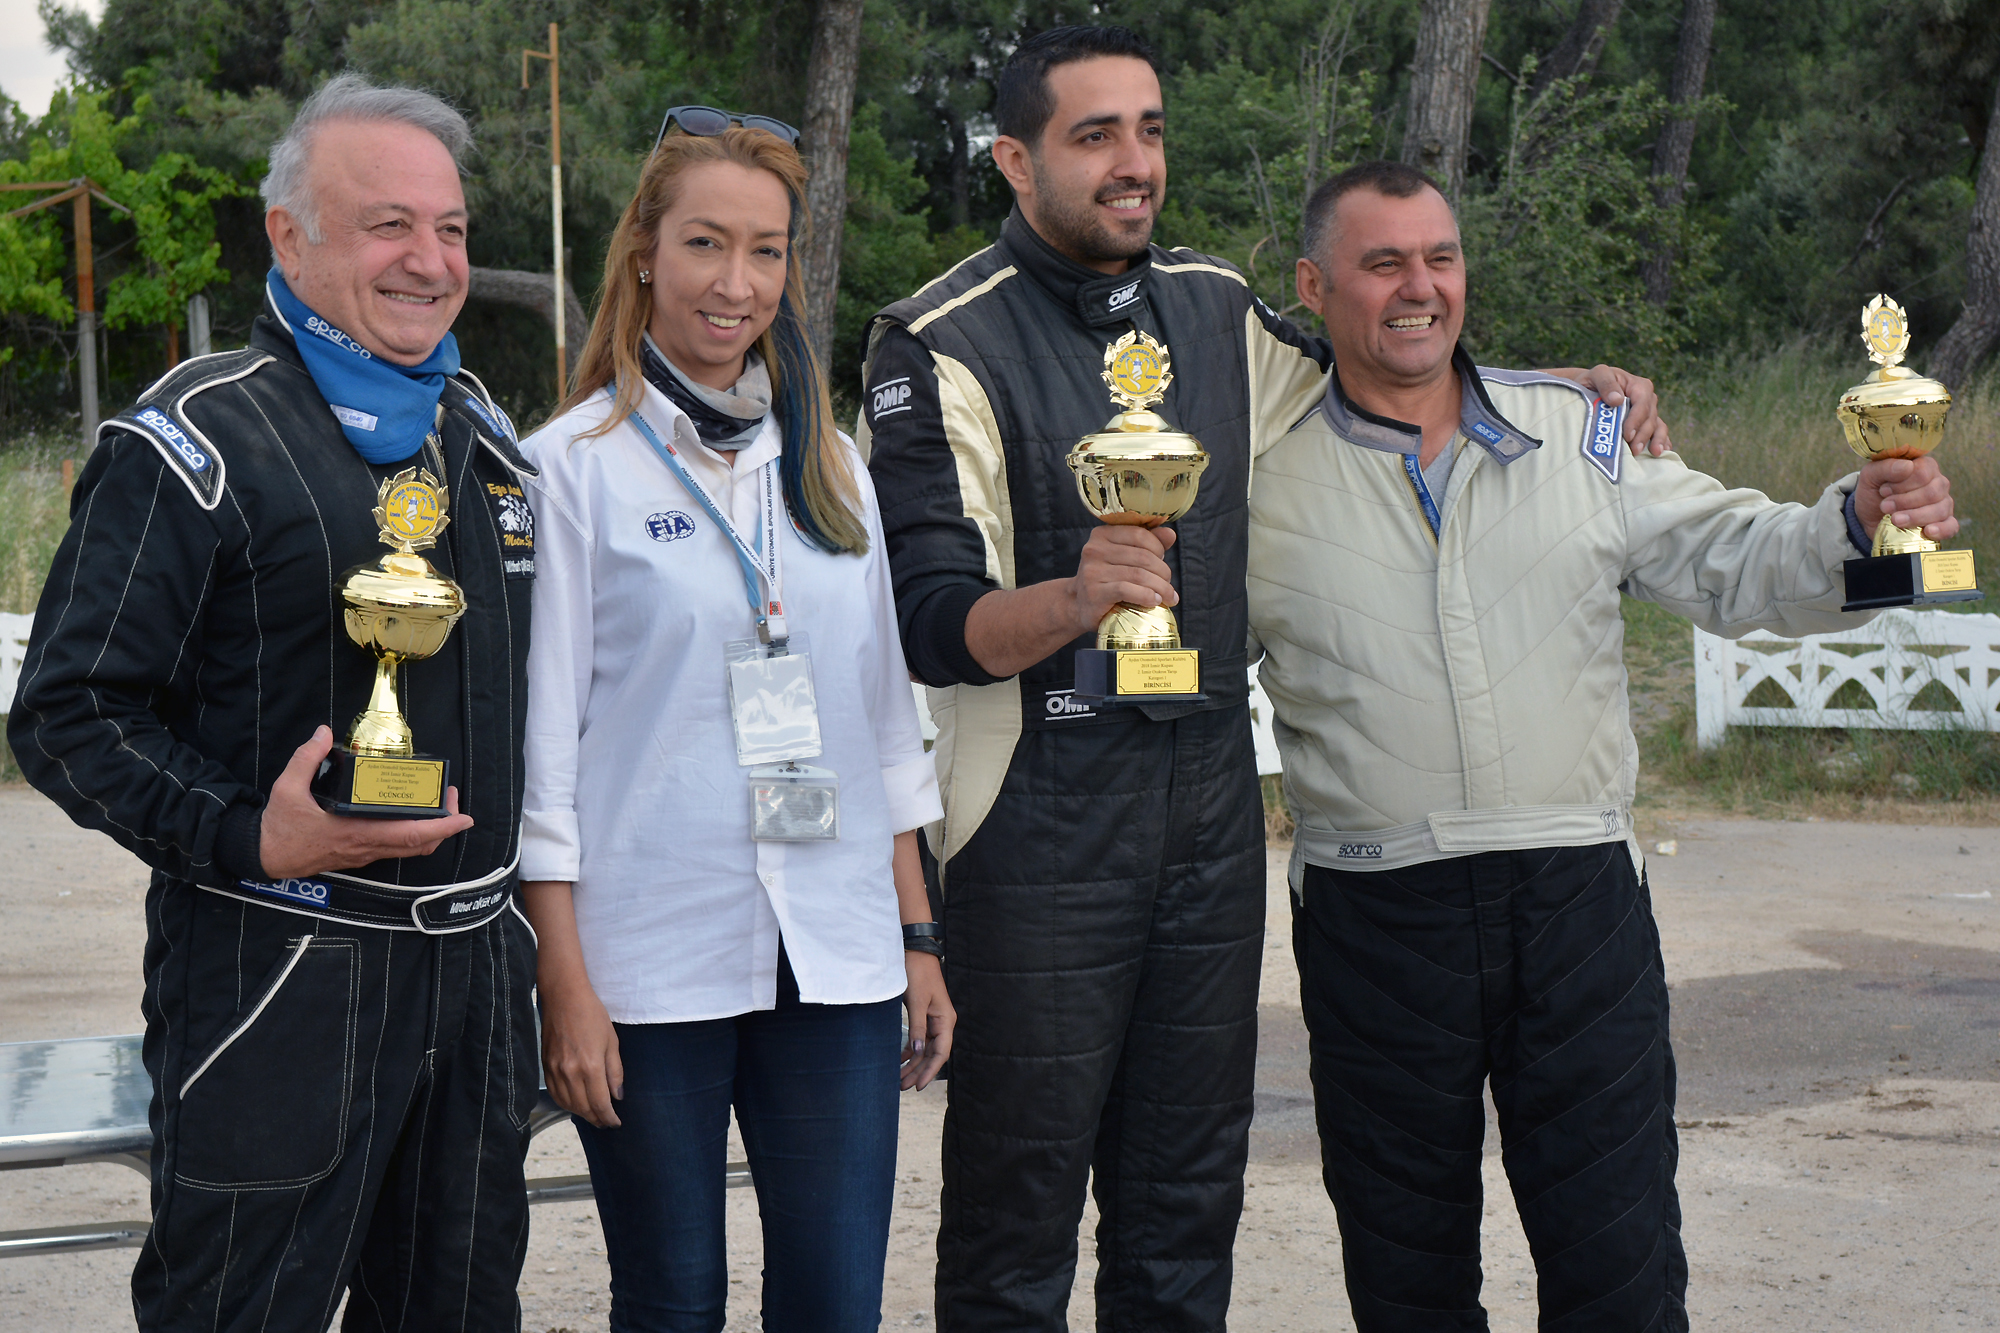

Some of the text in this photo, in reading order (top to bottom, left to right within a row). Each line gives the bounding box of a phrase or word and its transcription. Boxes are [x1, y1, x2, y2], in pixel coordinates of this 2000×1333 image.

[1109, 284, 1138, 306] OMP
[304, 316, 372, 360] sparco
[874, 384, 912, 412] OMP
[466, 400, 498, 432] sparco
[136, 410, 206, 470] sparco
[1046, 695, 1090, 714] OM
[378, 791, 414, 799] ÜÇÜNCÜSÜ
[1338, 844, 1382, 858] sparco
